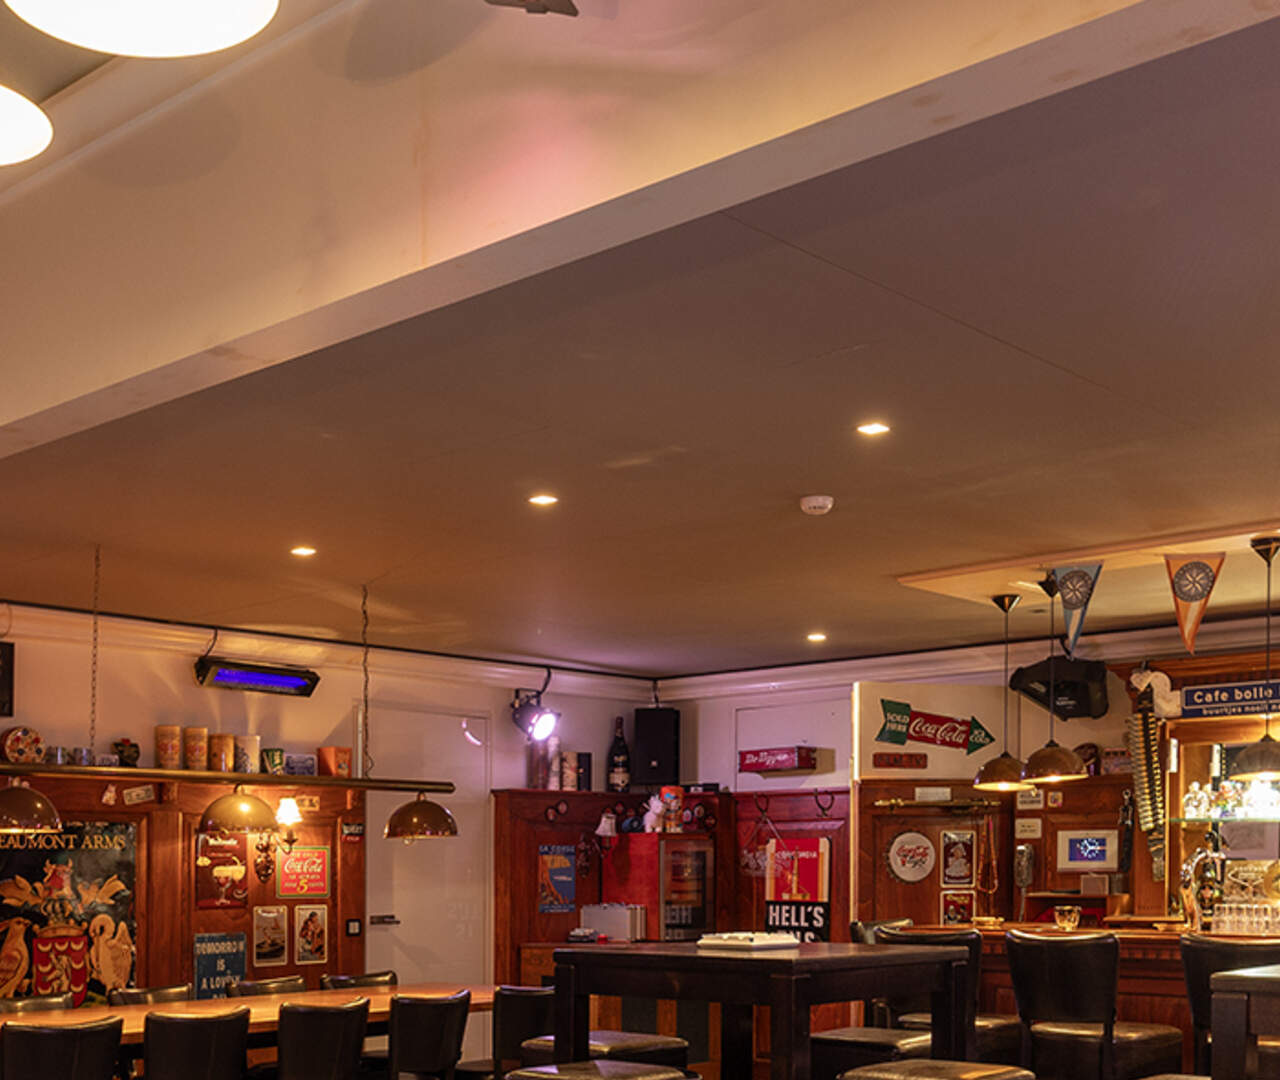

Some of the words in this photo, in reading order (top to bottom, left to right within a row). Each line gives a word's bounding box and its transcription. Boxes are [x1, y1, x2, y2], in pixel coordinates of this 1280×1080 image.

[1193, 690, 1230, 704] Cafe
[80, 834, 126, 850] ARMS
[296, 879, 309, 894] 5
[768, 904, 825, 928] HELL'S
